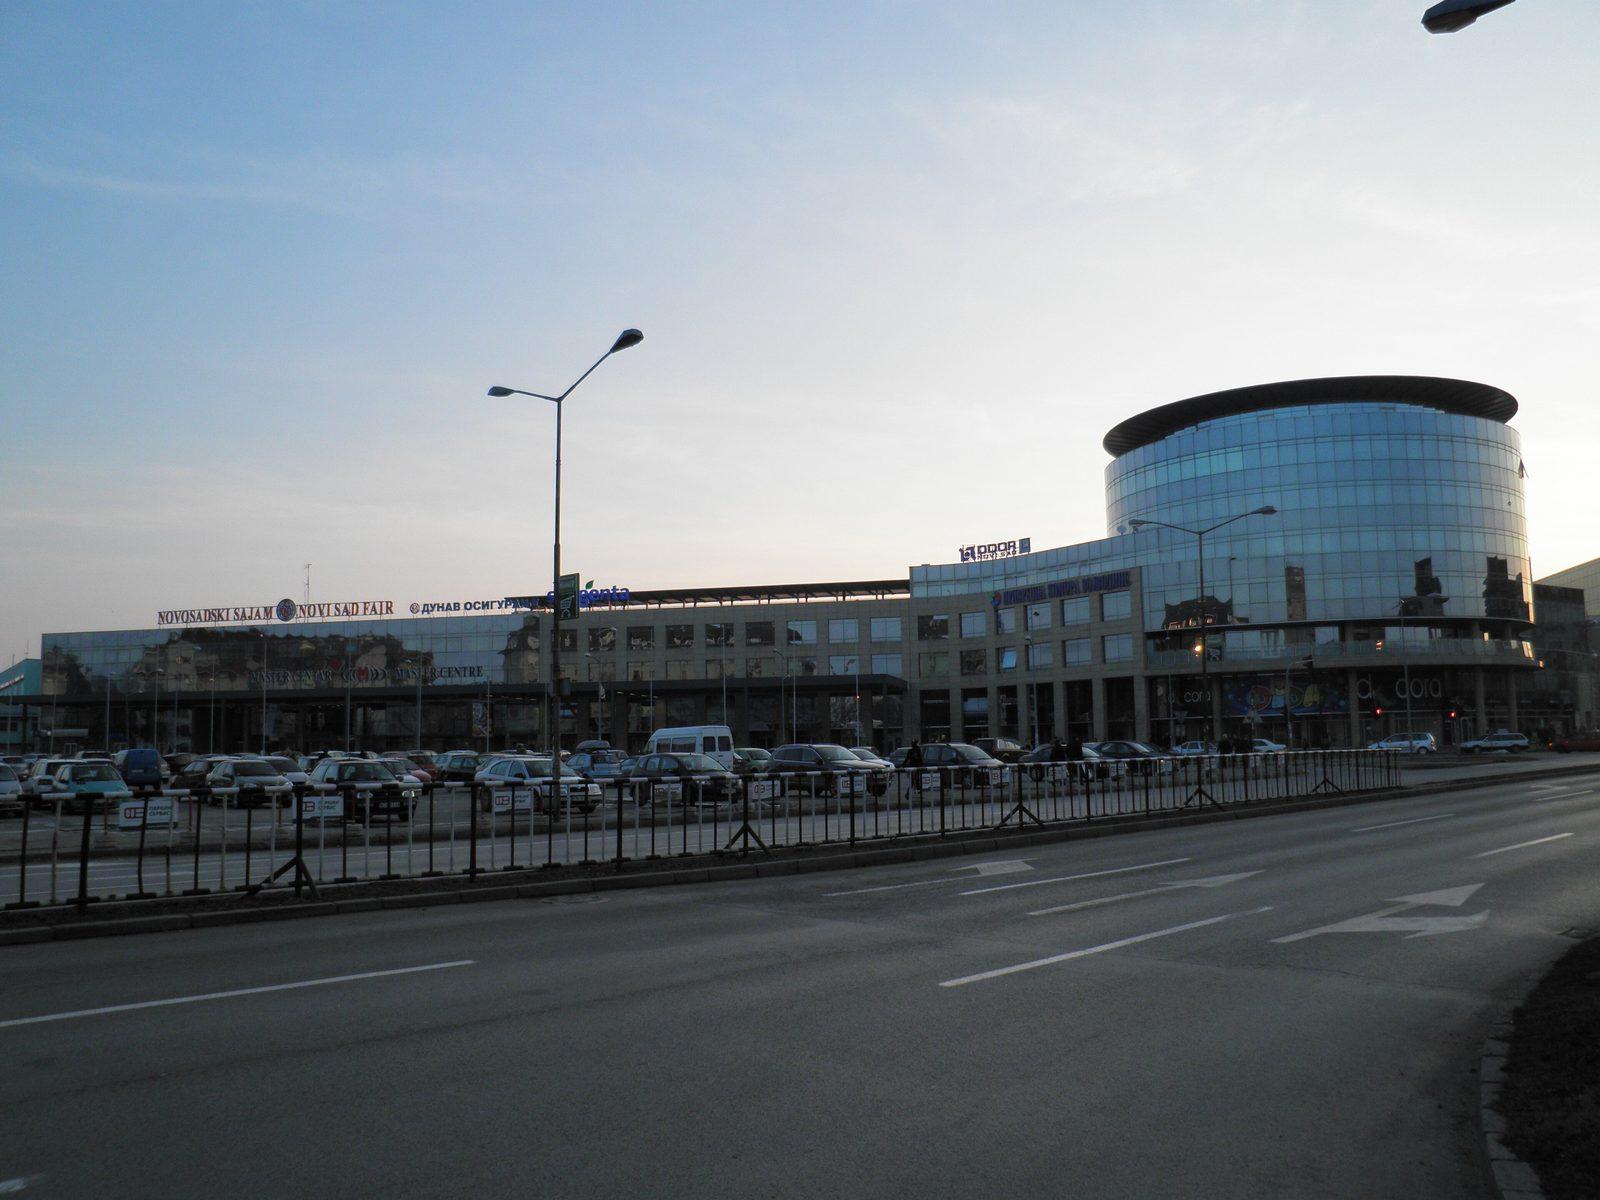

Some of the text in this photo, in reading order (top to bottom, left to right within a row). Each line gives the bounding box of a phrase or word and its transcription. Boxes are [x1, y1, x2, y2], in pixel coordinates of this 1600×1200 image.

[977, 541, 1017, 554] DDOR
[546, 585, 630, 608] sgenta
[157, 606, 274, 624] NOVOSADSKI SAJAM
[298, 600, 394, 618] NOVI SAD FAIR
[421, 602, 460, 615] ДУНАВ
[439, 666, 483, 678] CENTRE
